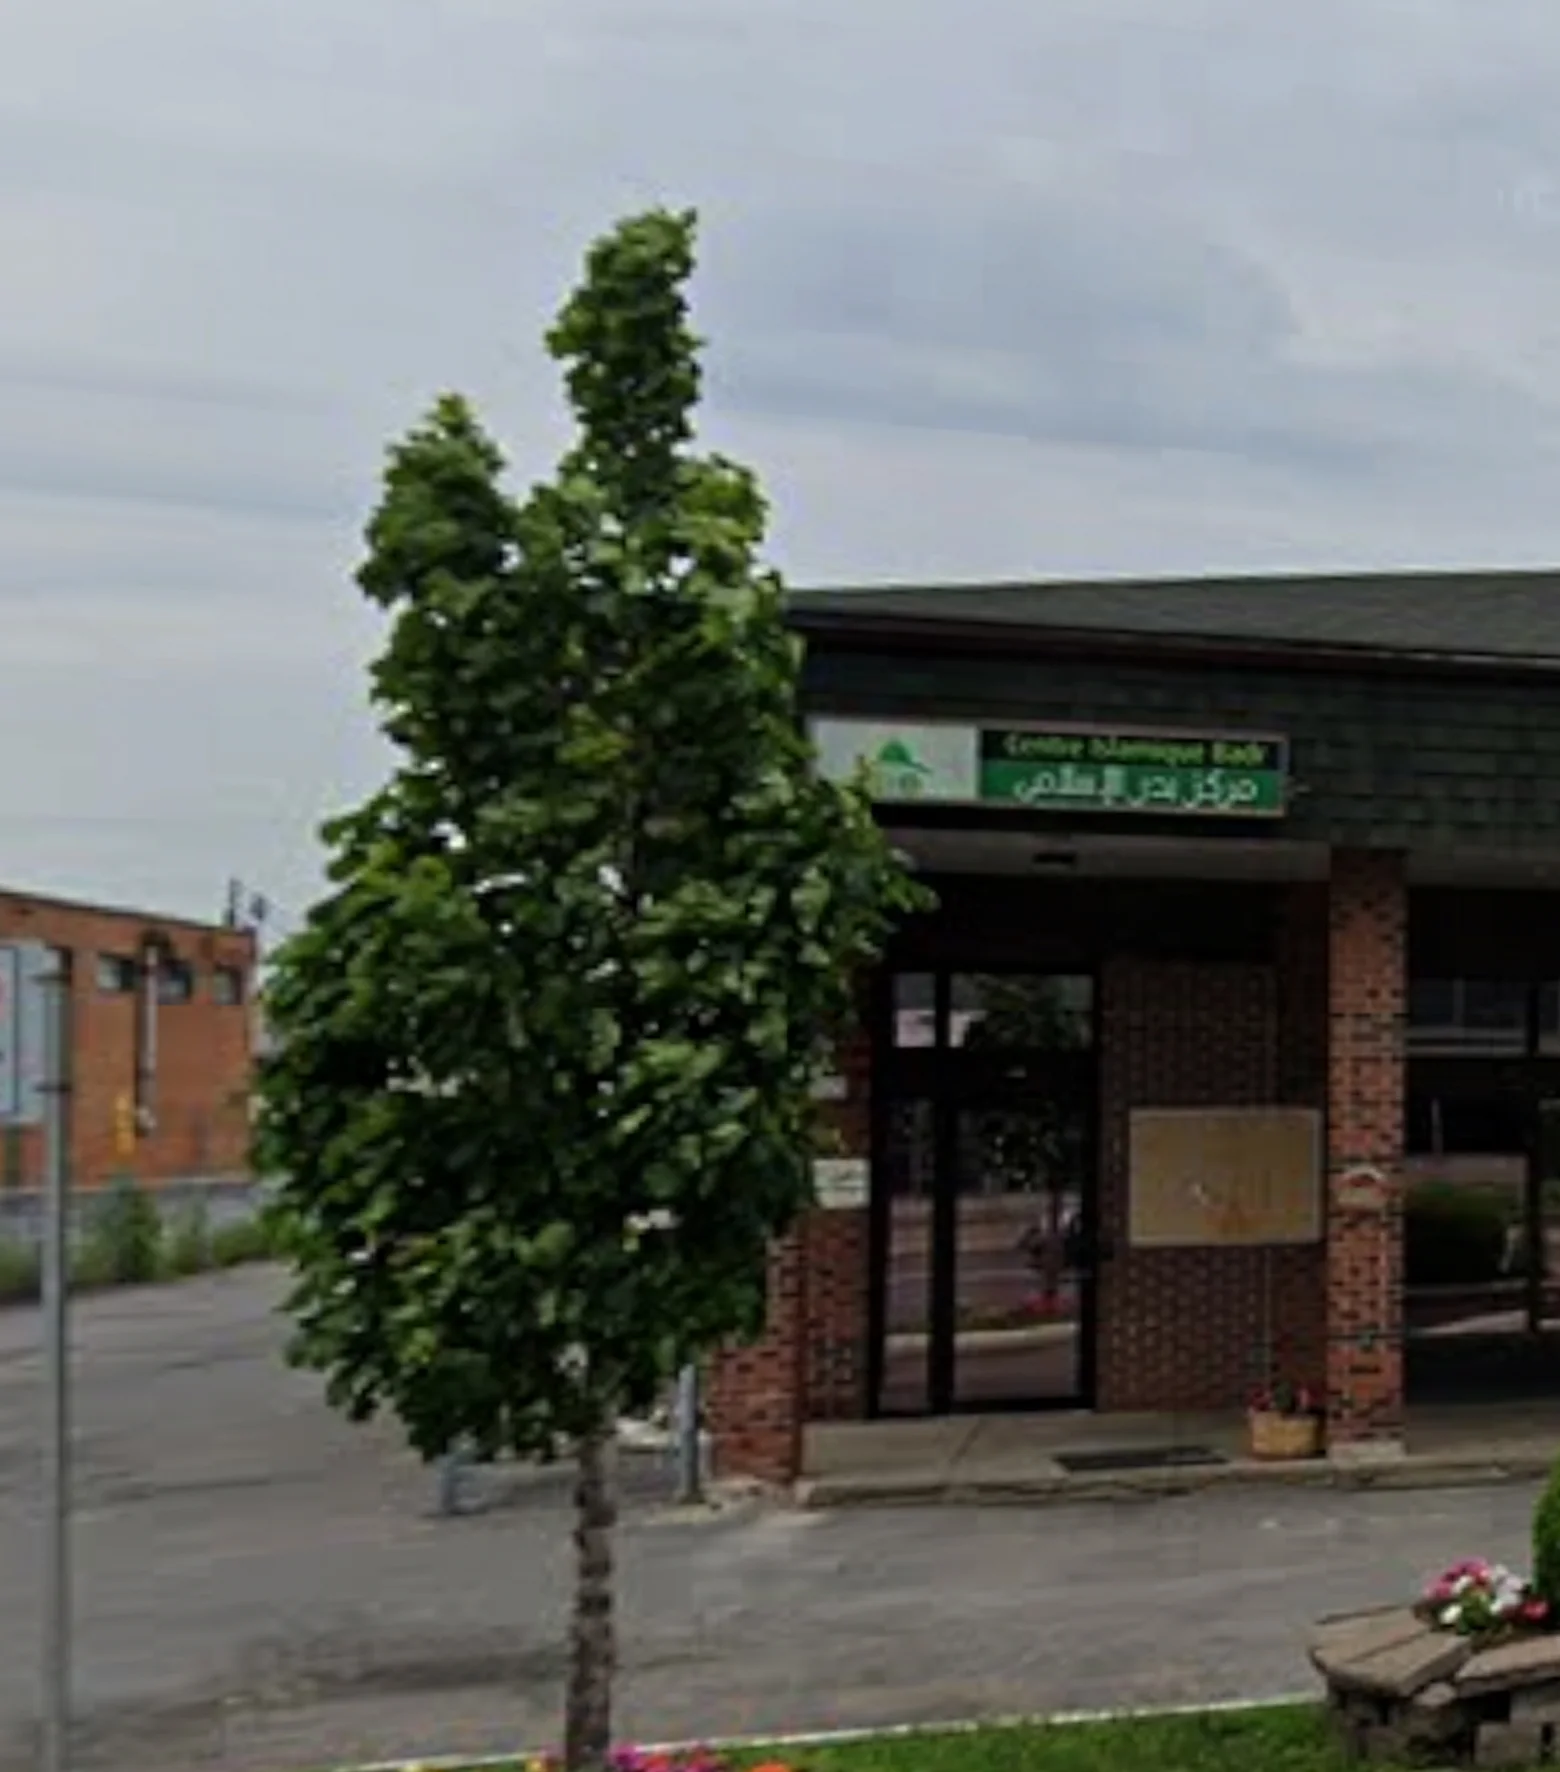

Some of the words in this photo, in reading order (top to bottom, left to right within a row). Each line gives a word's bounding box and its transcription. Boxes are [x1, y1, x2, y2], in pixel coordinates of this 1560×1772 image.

[1002, 731, 1084, 760] Centre
[1088, 735, 1204, 768] Islamique
[1212, 741, 1267, 766] Badr
[1181, 767, 1259, 810] مركز
